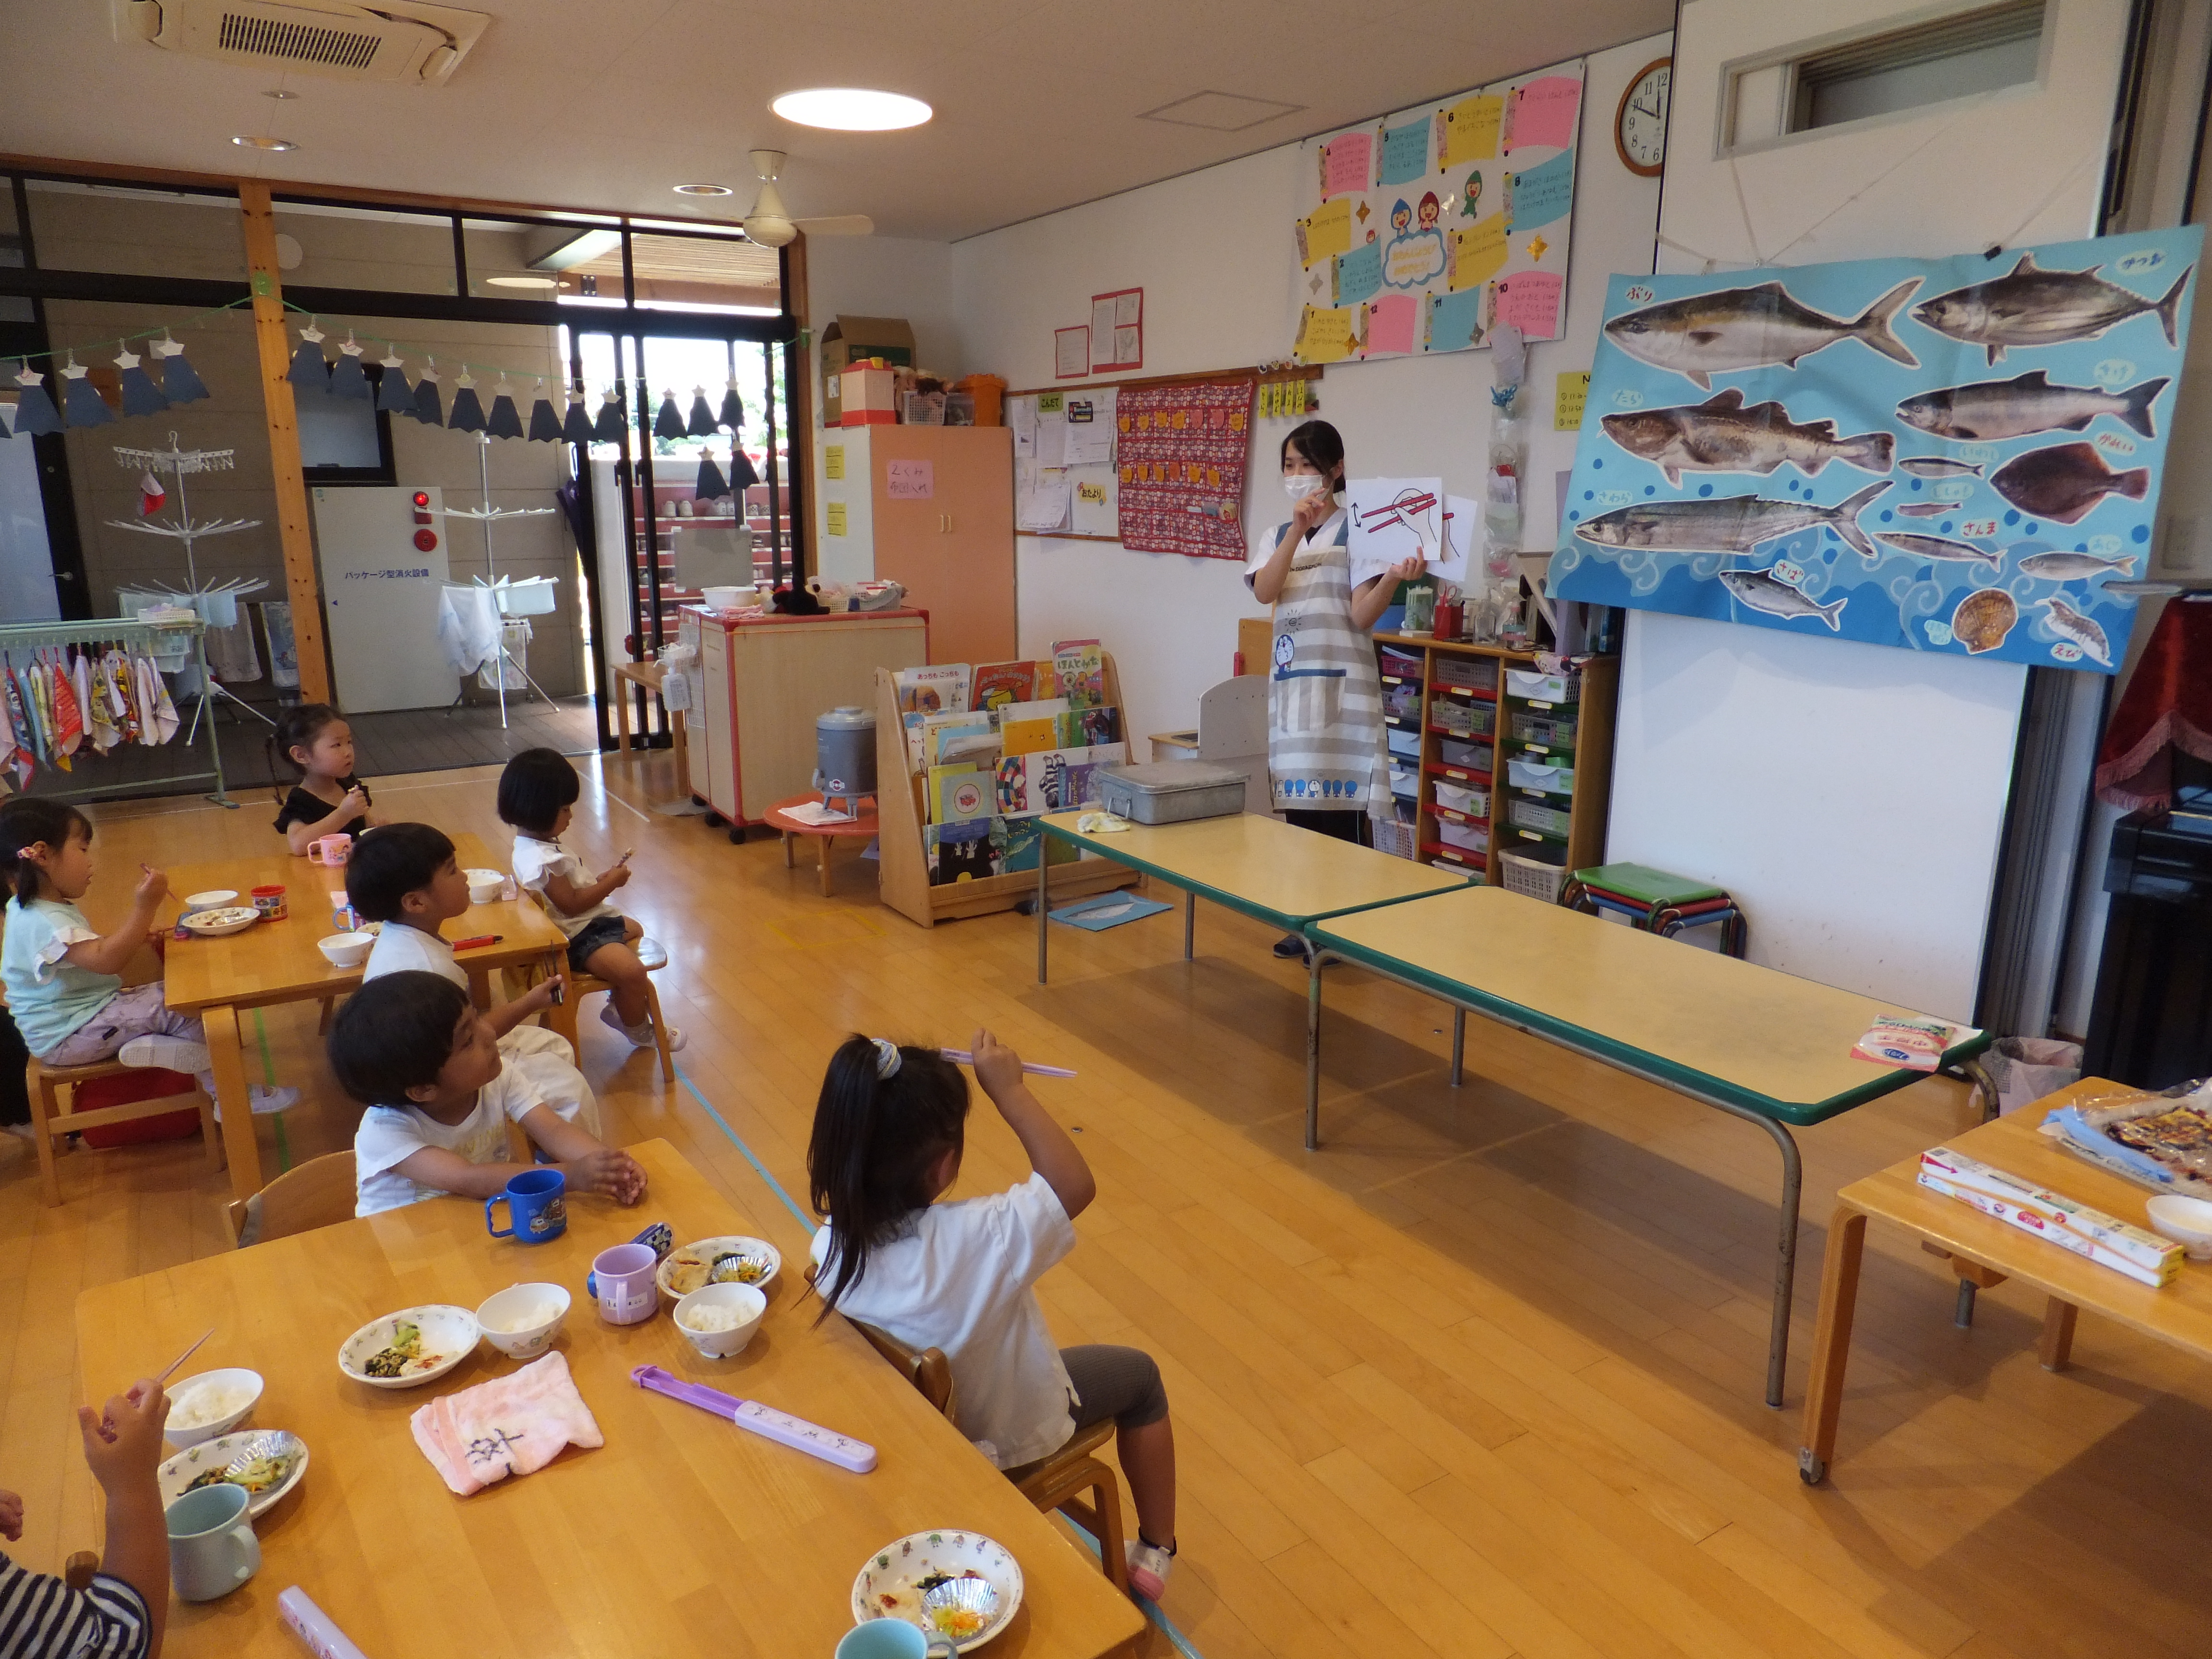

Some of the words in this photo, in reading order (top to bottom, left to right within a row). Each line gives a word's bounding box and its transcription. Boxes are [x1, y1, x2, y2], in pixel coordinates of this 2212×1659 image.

[1658, 73, 1668, 87] 12
[1645, 82, 1652, 95] 11
[1519, 90, 1525, 100] 7
[1633, 97, 1642, 111] 10
[1448, 112, 1454, 122] 6
[1629, 117, 1635, 130] 9
[1385, 132, 1389, 142] 5
[1632, 134, 1637, 147] 8
[1641, 146, 1647, 158] 7
[1653, 148, 1659, 161] 6
[1515, 176, 1521, 186] 8
[1306, 218, 1311, 227] 3
[1457, 235, 1463, 244] 9
[1339, 259, 1344, 268] 2
[1499, 283, 1508, 293] 10
[1626, 287, 1652, 302] ぶり
[1434, 298, 1442, 307] 11
[1370, 305, 1378, 314] 12
[1041, 397, 1059, 408] こんだて
[1082, 488, 1101, 499] おたより
[1963, 521, 1996, 536] さんま
[345, 568, 429, 579] パッケージ型消火設備
[1777, 562, 1803, 580] さば
[2055, 644, 2081, 658] えび
